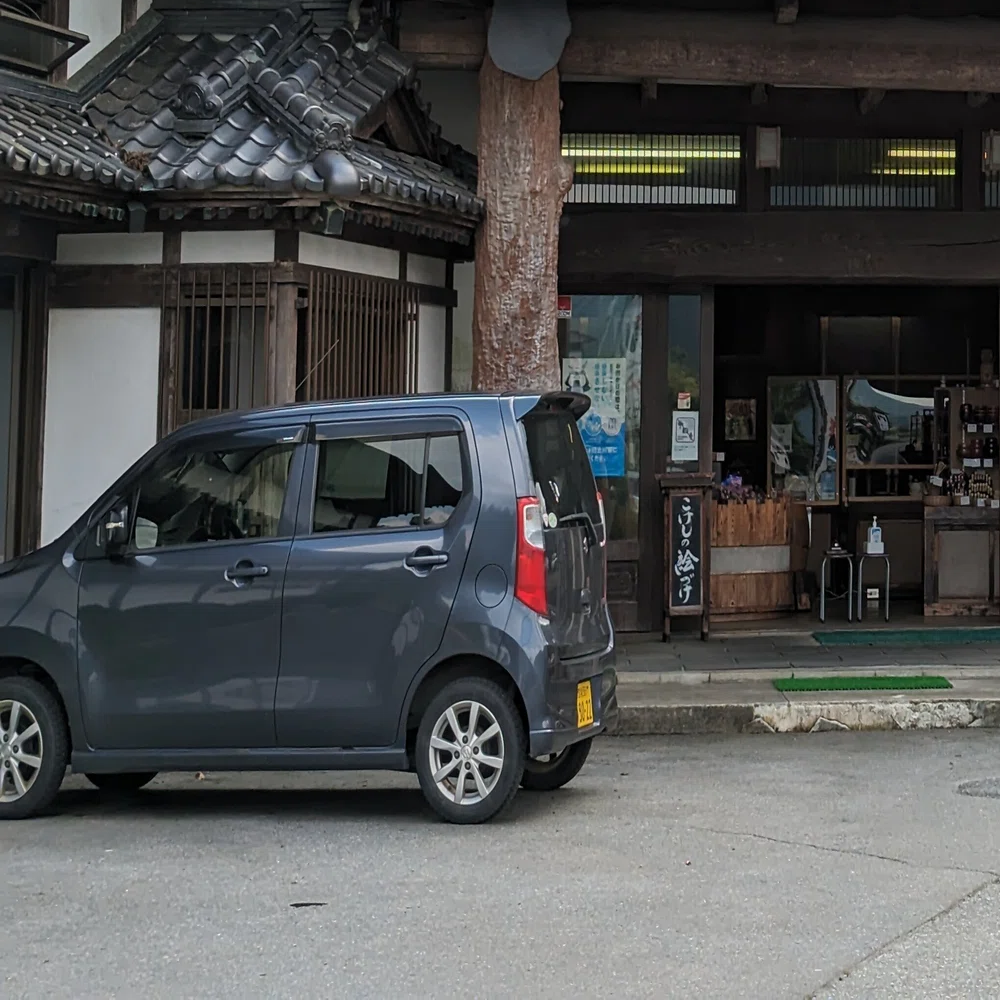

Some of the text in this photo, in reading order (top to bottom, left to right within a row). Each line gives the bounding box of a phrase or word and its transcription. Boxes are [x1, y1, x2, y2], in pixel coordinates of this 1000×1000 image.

[674, 497, 699, 604] こけしの絵づけ
